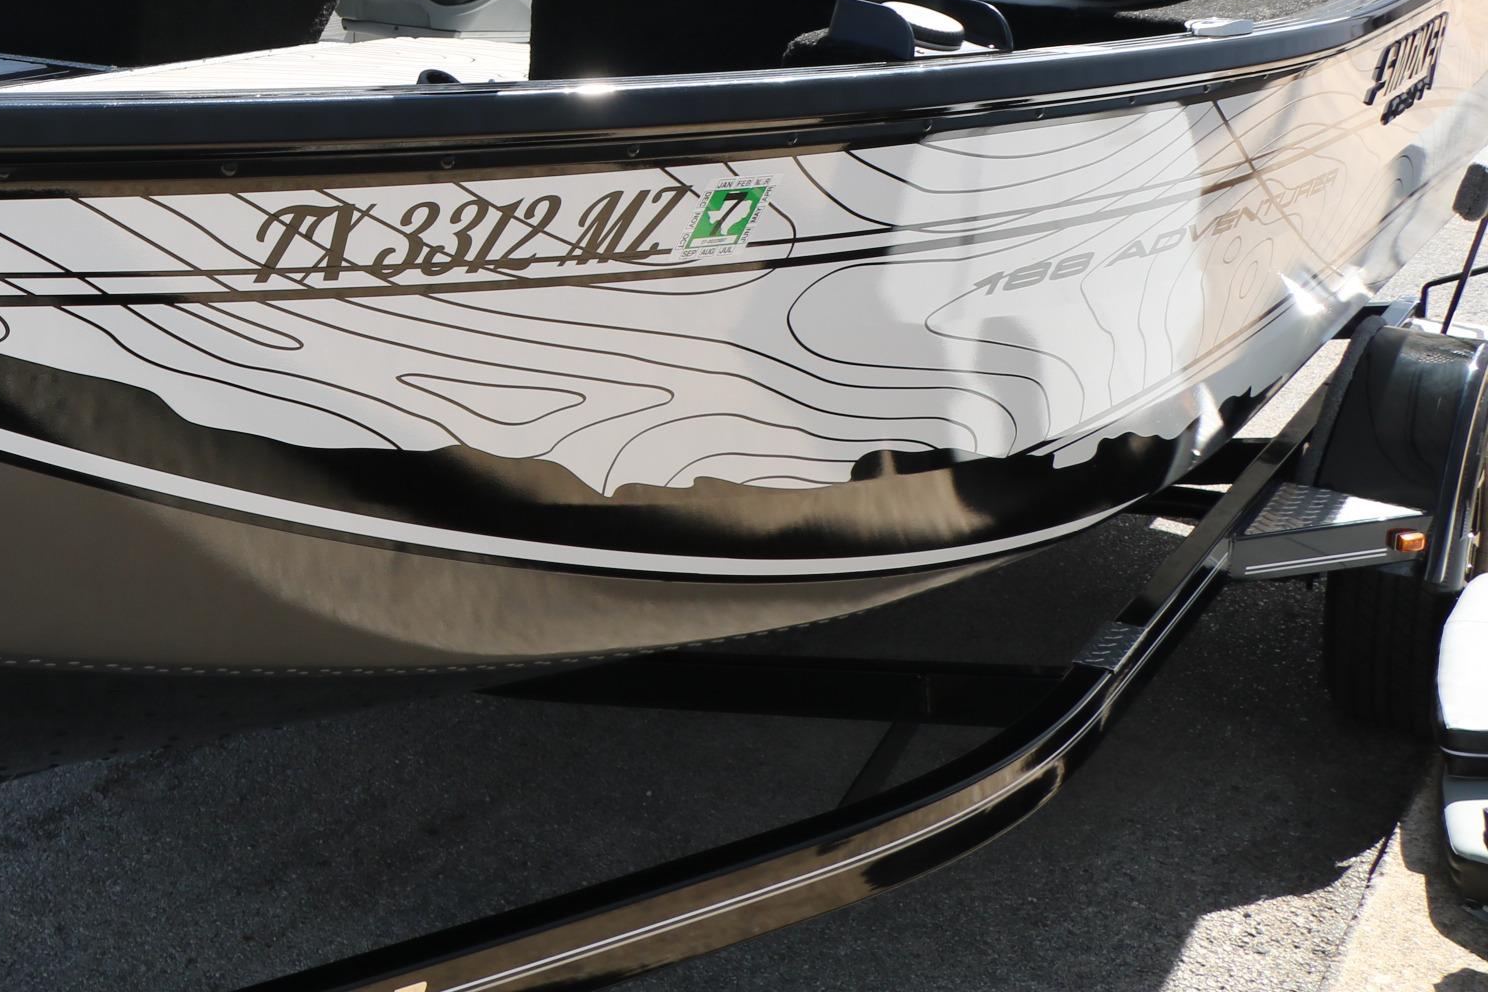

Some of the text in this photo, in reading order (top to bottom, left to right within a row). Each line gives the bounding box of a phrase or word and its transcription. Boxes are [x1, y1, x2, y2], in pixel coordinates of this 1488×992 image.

[717, 181, 734, 189] JAN
[709, 191, 749, 237] 7
[253, 203, 377, 283] TX
[557, 184, 694, 267] MZ
[682, 249, 697, 258] SEP
